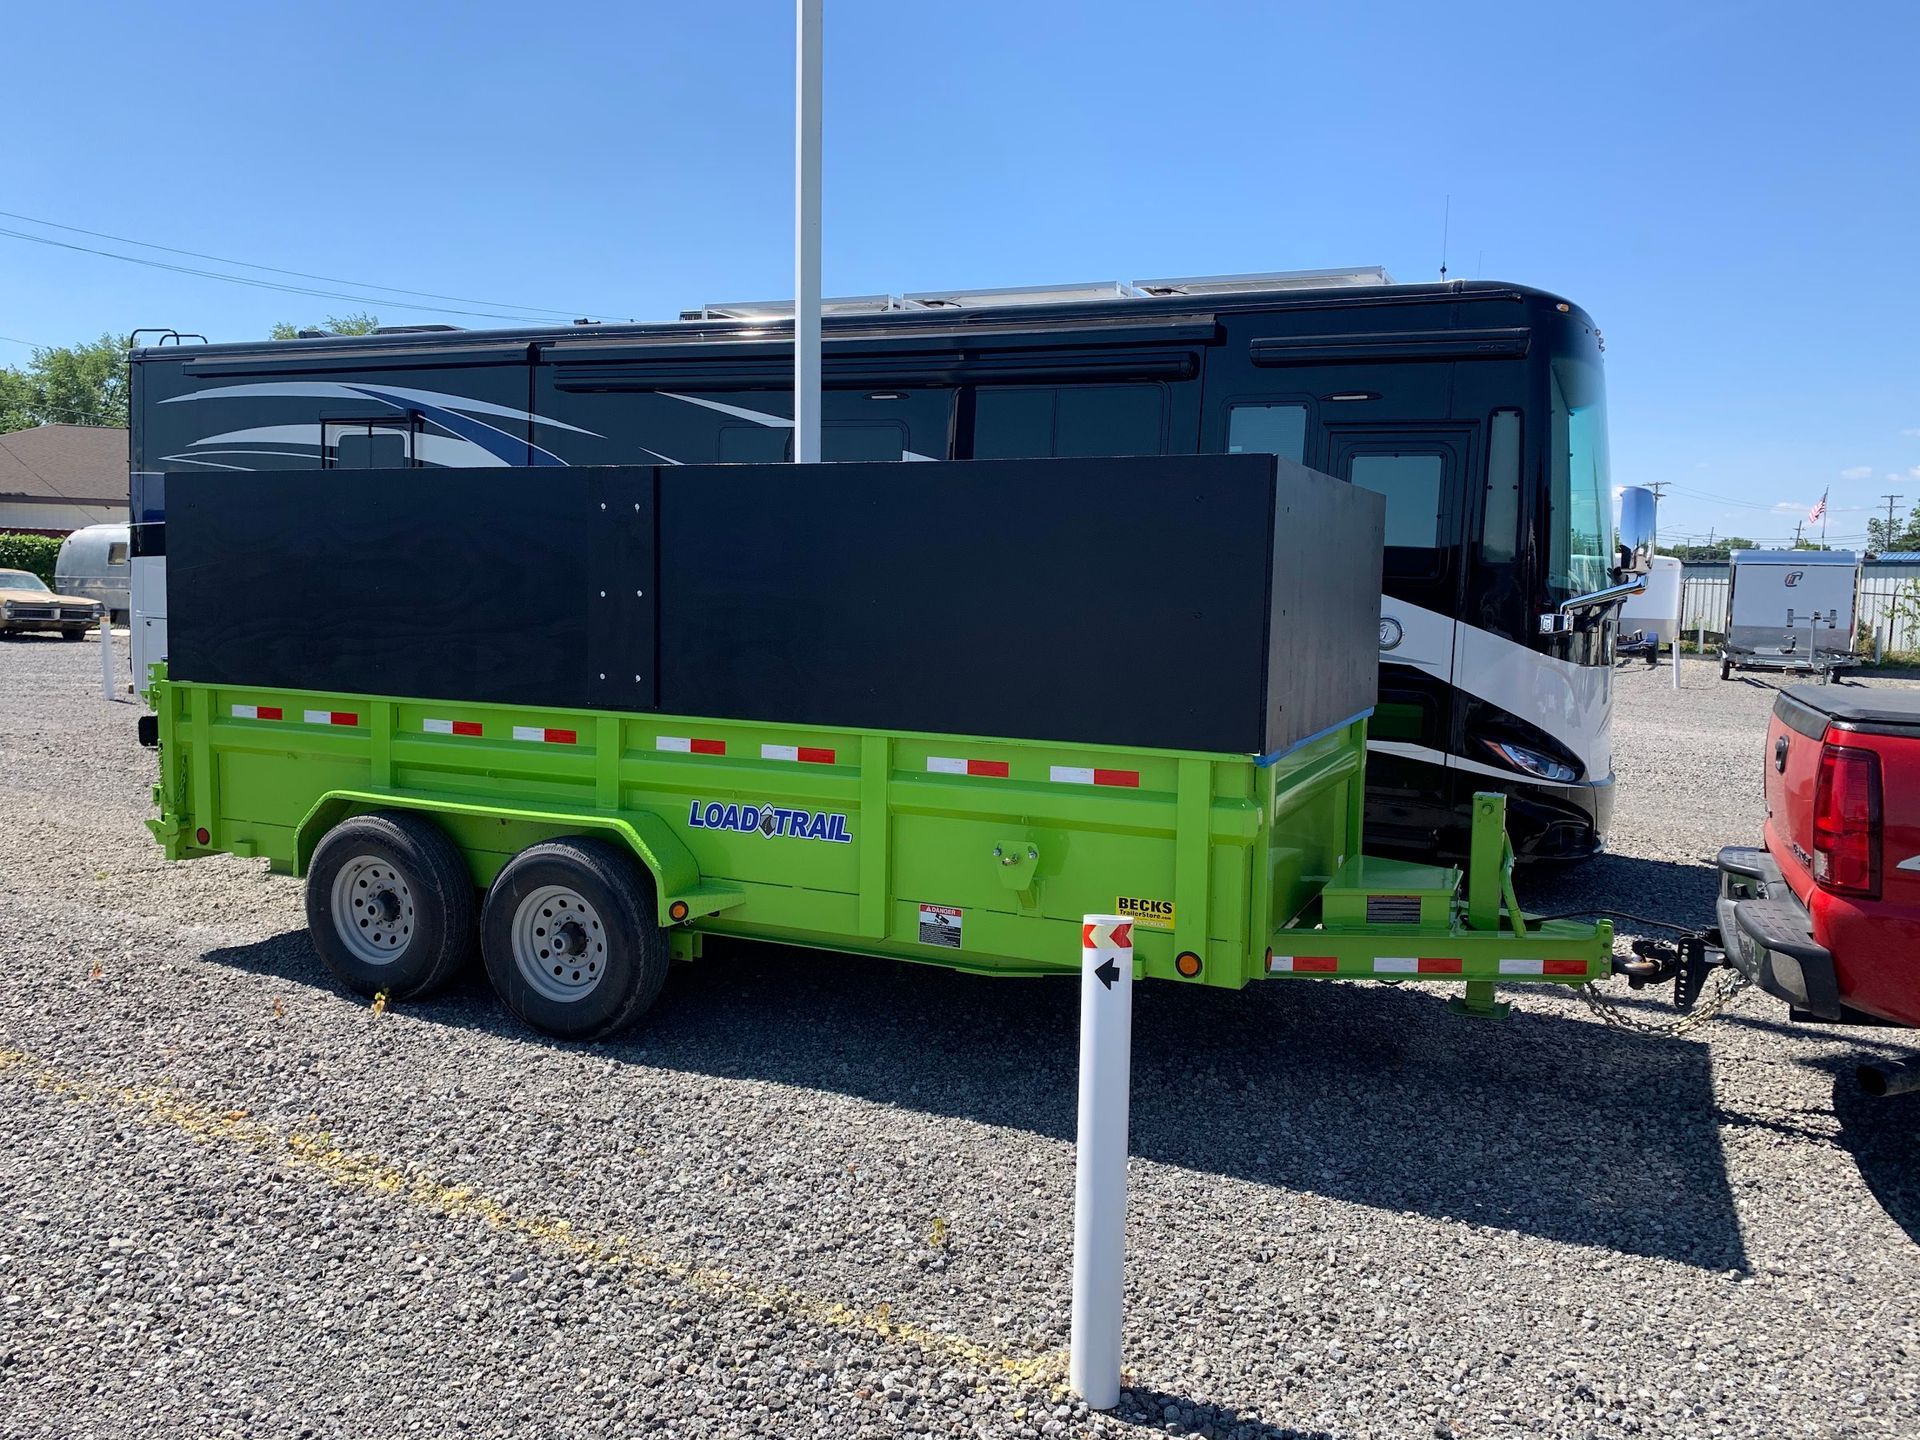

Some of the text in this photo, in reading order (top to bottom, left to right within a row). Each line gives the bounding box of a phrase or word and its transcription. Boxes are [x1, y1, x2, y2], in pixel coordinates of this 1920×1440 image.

[690, 801, 852, 842] LOAD TRAIL
[931, 908, 956, 916] DANGER
[1118, 897, 1173, 914] BECKS
